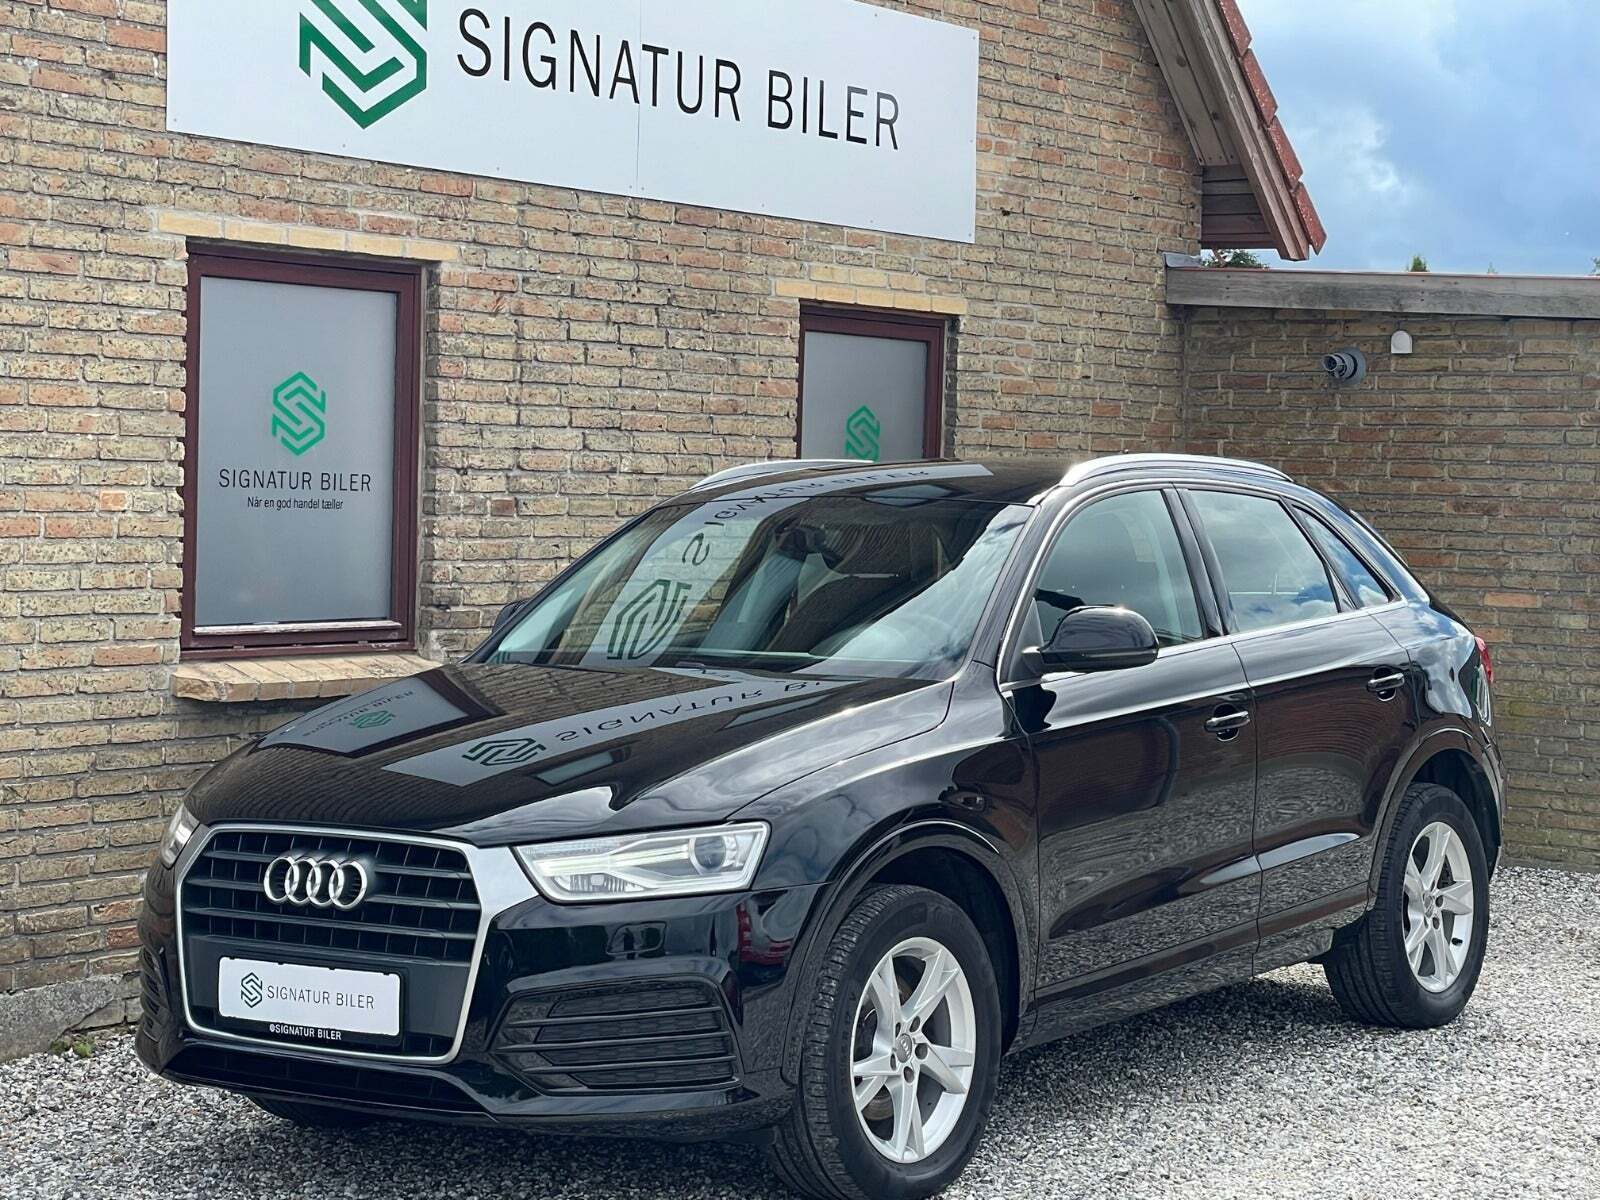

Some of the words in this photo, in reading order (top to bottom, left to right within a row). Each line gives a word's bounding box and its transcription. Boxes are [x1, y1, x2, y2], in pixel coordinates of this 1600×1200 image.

[457, 8, 741, 122] SIGNATUR
[767, 69, 899, 150] BILER
[218, 468, 312, 491] SIGNATUR
[320, 472, 372, 492] BILER
[247, 496, 263, 508] Når
[264, 499, 275, 508] en
[276, 499, 292, 511] god
[293, 499, 320, 509] handel
[321, 499, 344, 510] tæller
[266, 985, 330, 1005] SIGNATUR
[336, 992, 375, 1009] BILER
[317, 1029, 342, 1041] BILER
